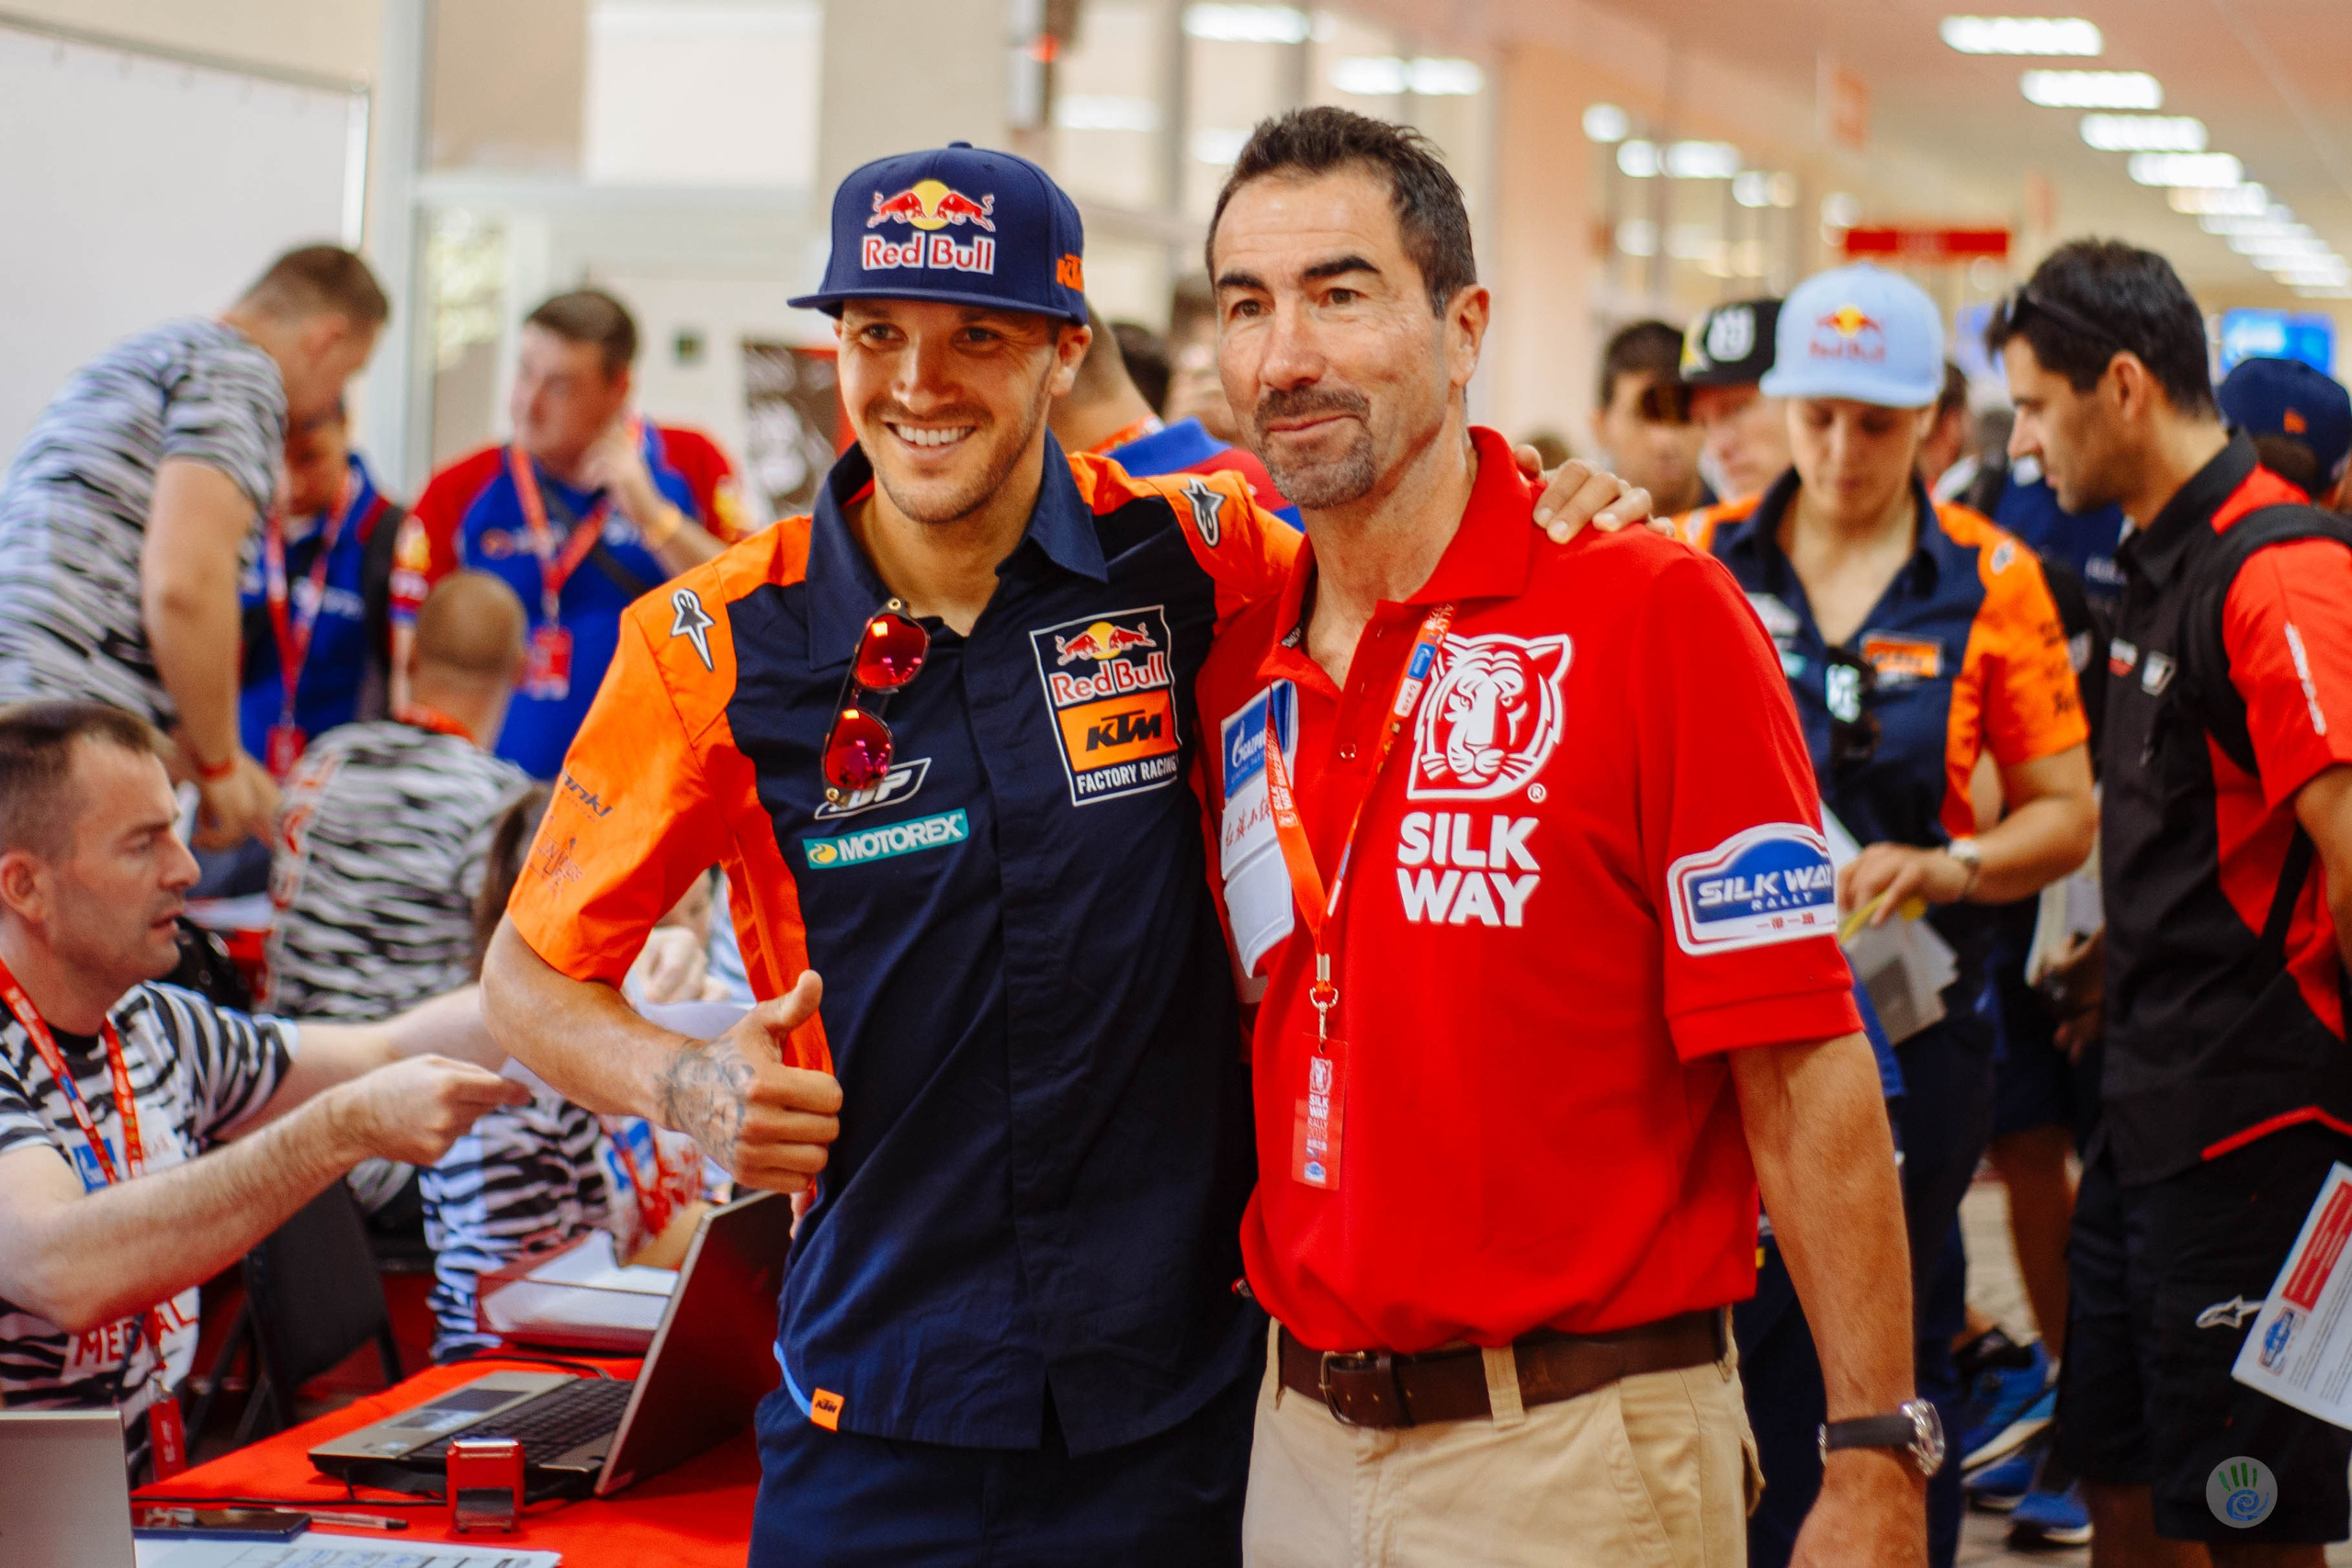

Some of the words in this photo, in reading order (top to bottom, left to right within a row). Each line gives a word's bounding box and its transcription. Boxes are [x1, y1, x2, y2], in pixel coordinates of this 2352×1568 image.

[863, 231, 925, 270] Red
[929, 235, 995, 275] Bull
[1049, 660, 1116, 706] Red
[1112, 651, 1170, 693] Bull
[1086, 709, 1161, 751] KTM
[1076, 764, 1138, 795] FACTORY
[838, 814, 963, 862] MOTOREX
[1397, 812, 1541, 872] SILK
[1396, 867, 1541, 928] WAY
[1698, 872, 1781, 907] SILK
[1750, 892, 1813, 911] RALLY
